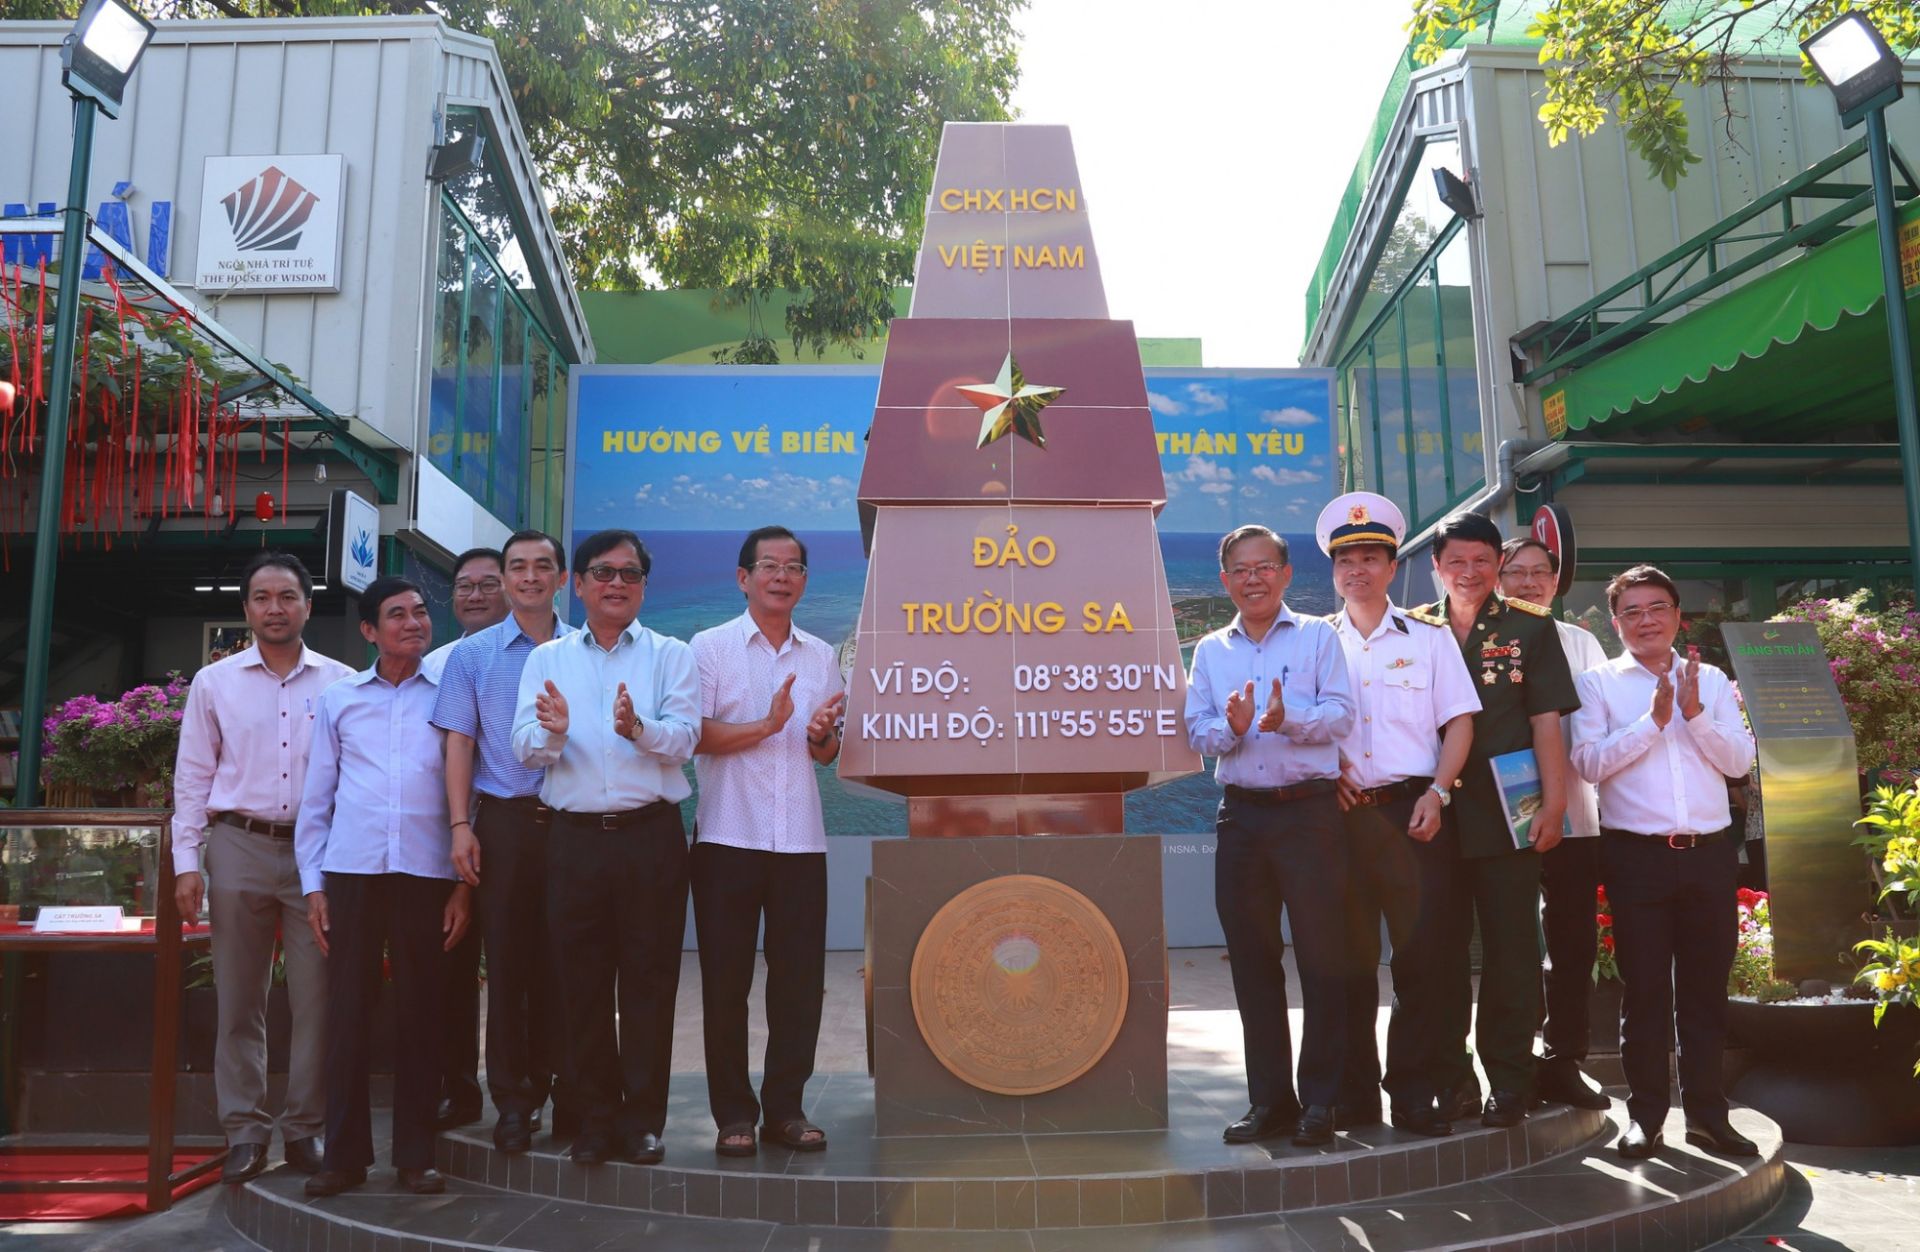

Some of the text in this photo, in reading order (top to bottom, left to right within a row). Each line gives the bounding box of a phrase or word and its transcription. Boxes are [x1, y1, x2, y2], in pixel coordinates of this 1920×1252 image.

[939, 188, 1077, 212] CHXHCN
[246, 258, 269, 269] NHÀ
[937, 239, 1085, 274] VIỆT NAM
[203, 273, 326, 283] THE HOUSE OF WISDOM
[602, 423, 856, 453] HƯỚNG VỀ BIỂN
[1155, 428, 1305, 455] THÂN YÊU
[972, 524, 1057, 567] ĐẢO
[901, 590, 1134, 634] TRƯỜNG SA
[870, 661, 904, 694] VĨ
[911, 660, 970, 700] ĐỘ:
[862, 712, 938, 740] KINH
[947, 706, 1004, 746] ĐỘ:
